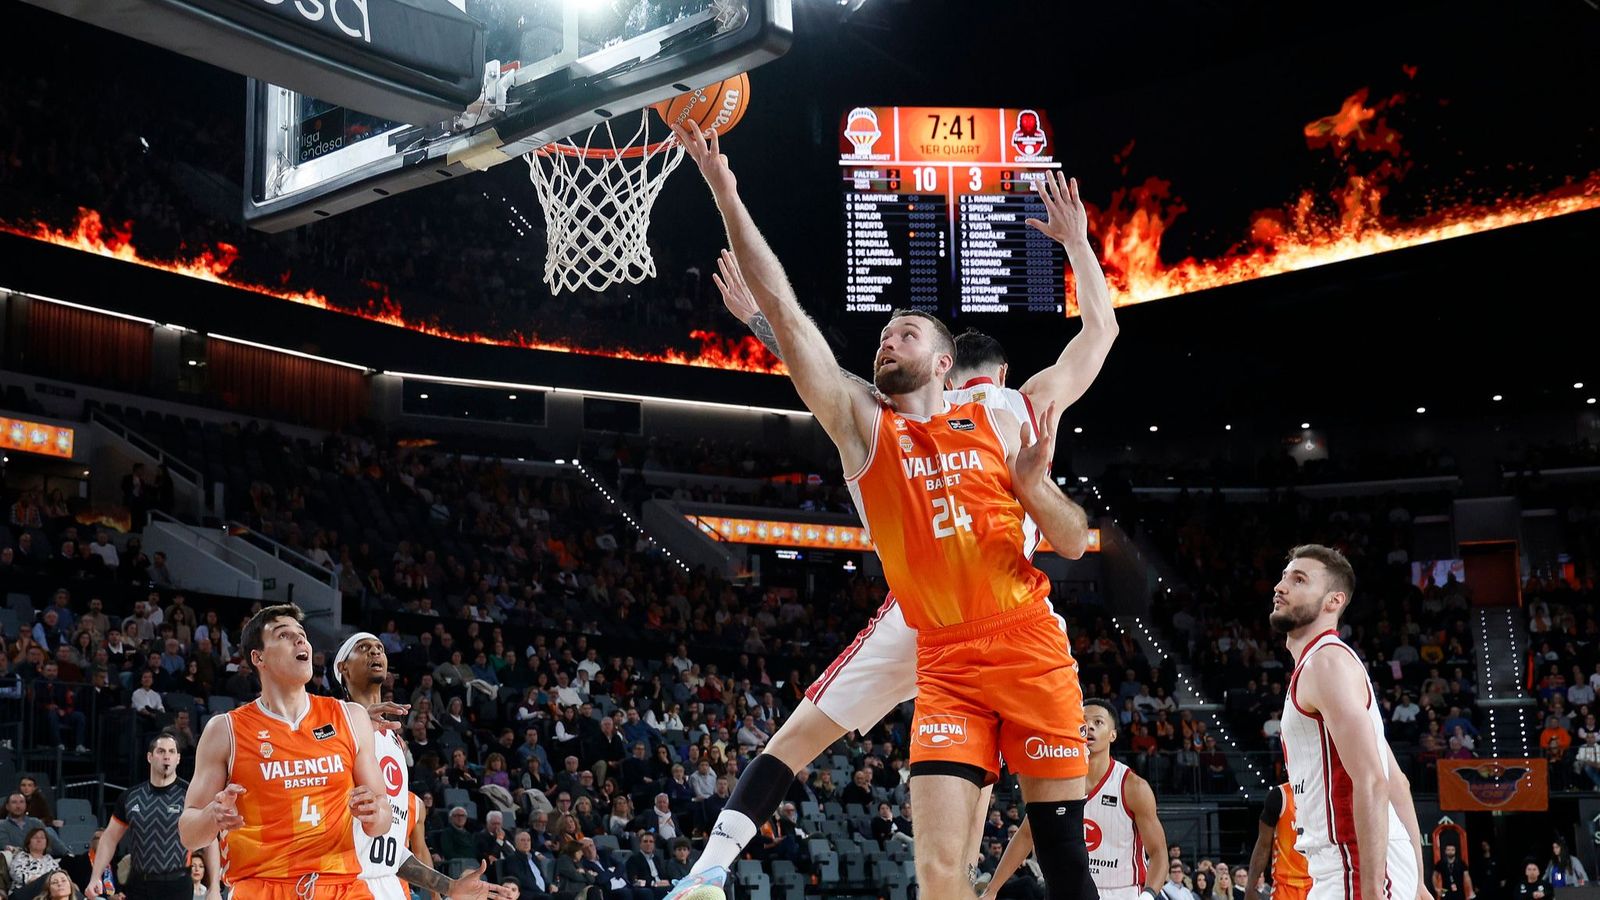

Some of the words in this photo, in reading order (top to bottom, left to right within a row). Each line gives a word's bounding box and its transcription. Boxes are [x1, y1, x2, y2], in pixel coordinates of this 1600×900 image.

[264, 0, 371, 43] sa
[928, 115, 975, 140] 7:41
[300, 131, 320, 148] liga
[301, 136, 343, 160] endesa
[920, 145, 940, 154] 1ER
[944, 146, 980, 155] QUART
[891, 170, 895, 178] 2
[913, 168, 937, 191] 10
[969, 168, 982, 191] 3
[1020, 172, 1045, 181] FALTES
[854, 194, 861, 202] P.
[846, 203, 852, 211] 0
[854, 203, 877, 211] BADIO
[939, 231, 944, 239] 2
[969, 231, 1005, 239] GONZÁLEZ
[855, 249, 865, 257] DE
[867, 249, 894, 257] LARREA
[970, 249, 1012, 257] FERNÁNDEZ
[856, 276, 892, 284] MONTERO
[902, 450, 983, 479] VALNCIA
[926, 474, 960, 490] BAET
[932, 495, 973, 539] 24
[919, 724, 963, 736] PULEVA
[1029, 740, 1079, 759] Midea
[260, 754, 344, 780] VALENCIA
[285, 776, 328, 789] BASKET
[300, 796, 320, 826] 4
[370, 836, 396, 867] 00
